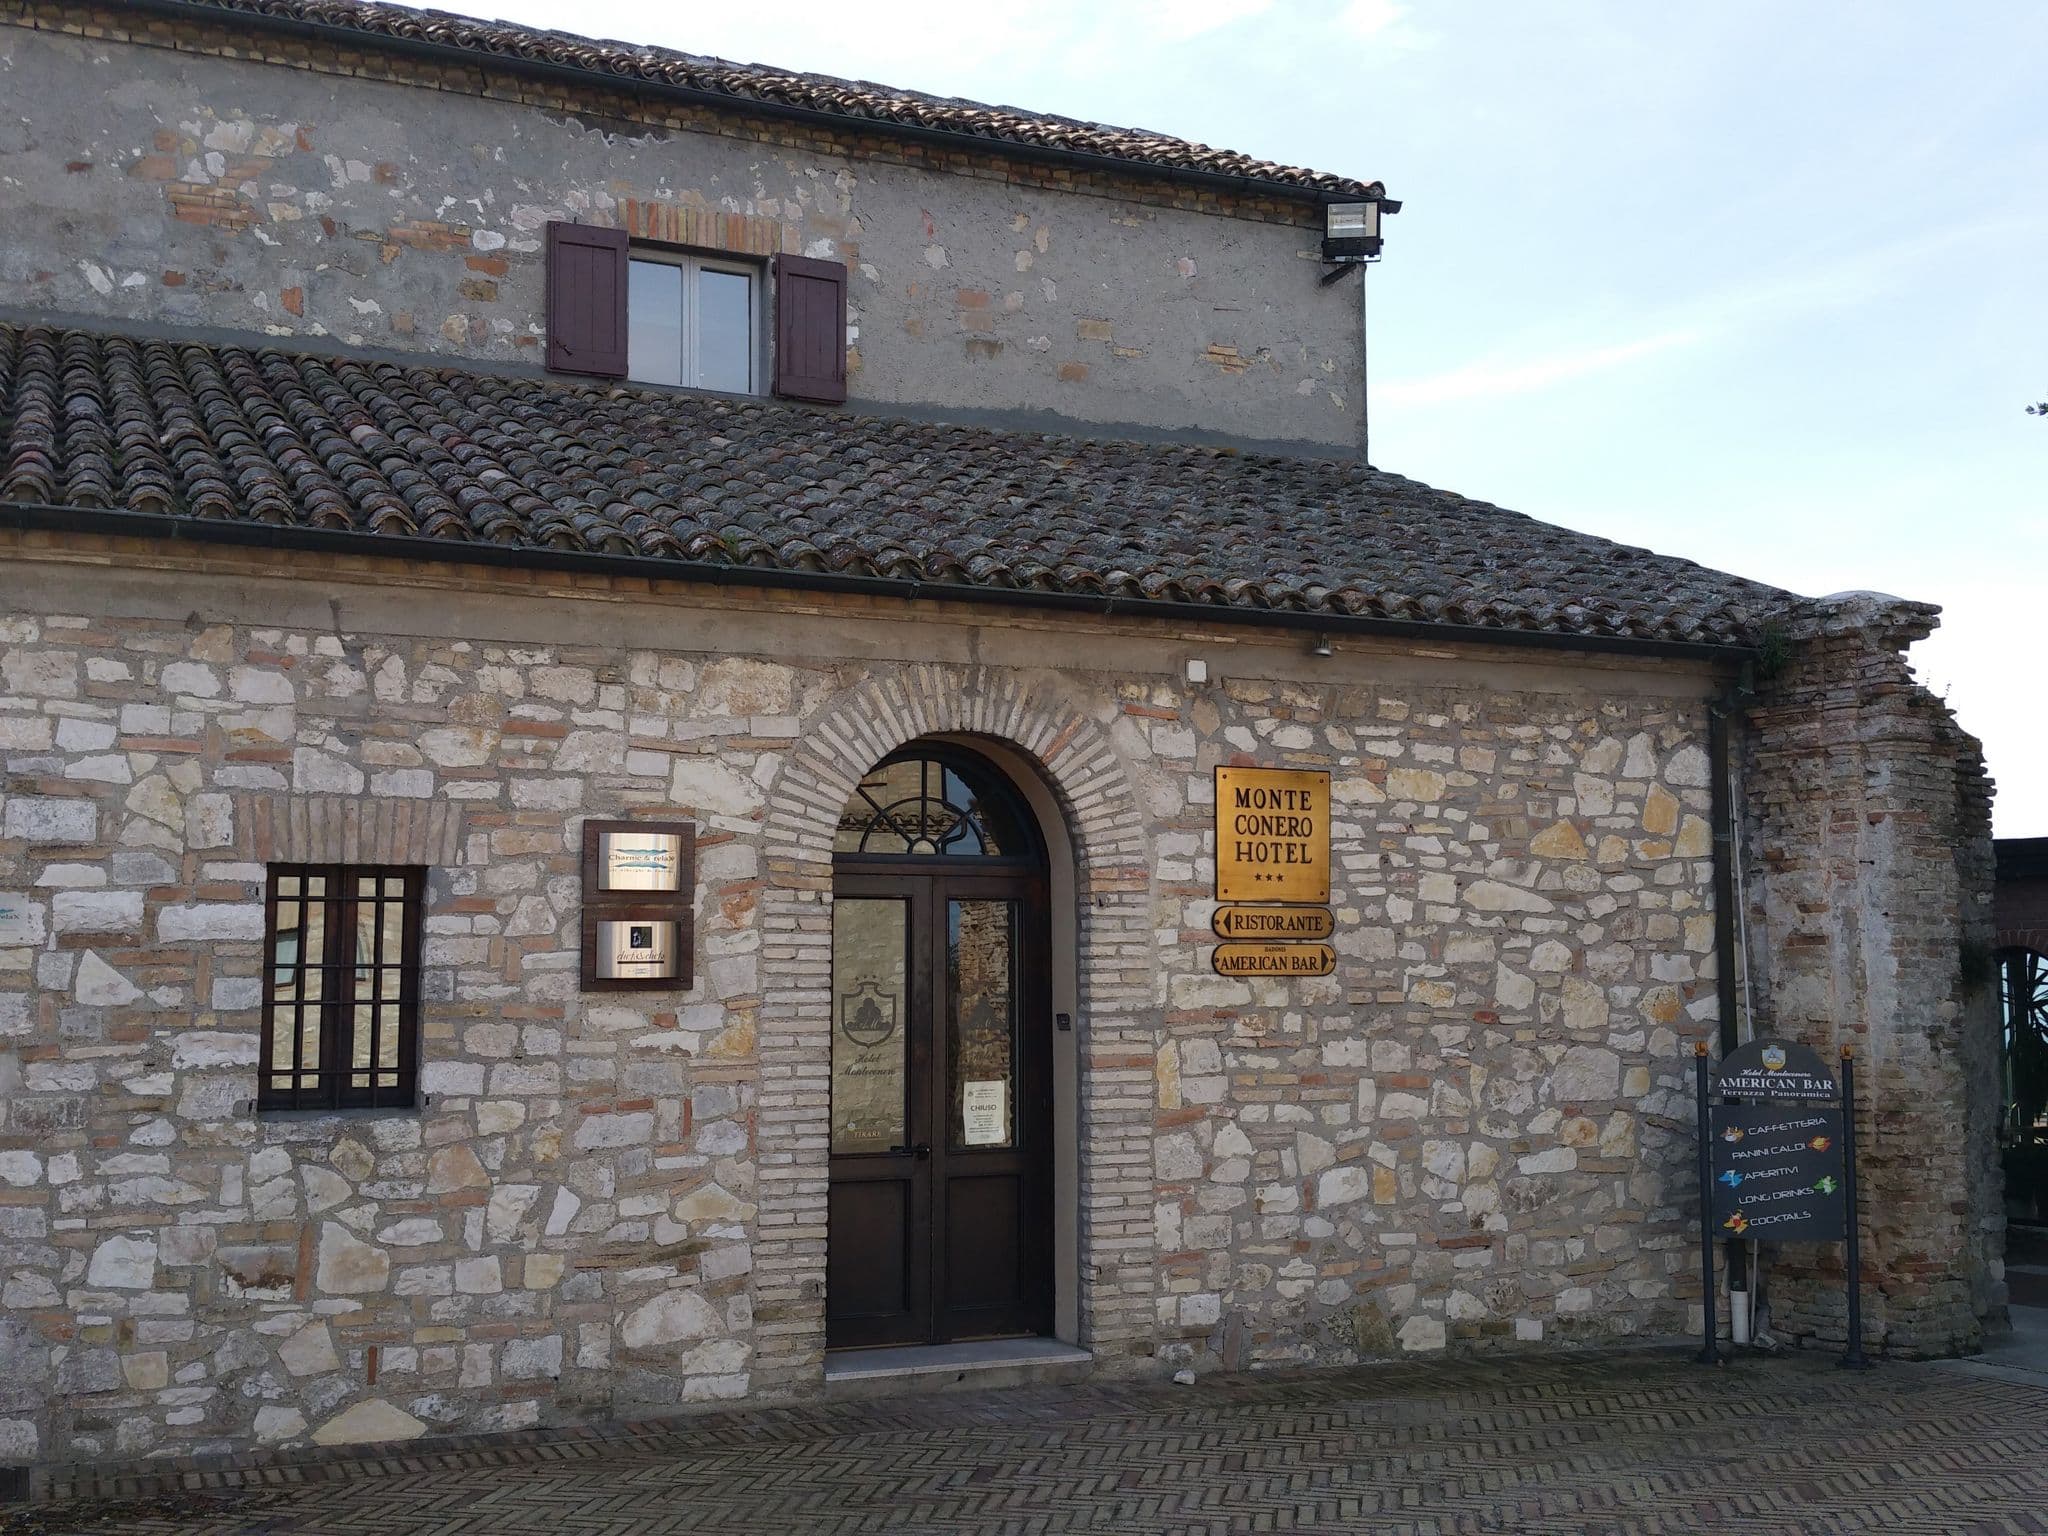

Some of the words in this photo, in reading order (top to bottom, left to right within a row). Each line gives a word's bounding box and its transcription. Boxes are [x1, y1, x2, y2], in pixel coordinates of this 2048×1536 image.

[1235, 787, 1312, 811] MONTE
[1235, 814, 1313, 838] CONERO
[1235, 841, 1313, 865] HOTEL
[1234, 914, 1323, 931] RISTORANTE
[1220, 955, 1288, 971] AMERICAN
[1292, 956, 1319, 971] BAR
[1718, 1077, 1796, 1089] AMERICAN
[1803, 1079, 1833, 1090] BAR
[1720, 1089, 1765, 1097] Terrazza
[1770, 1090, 1831, 1098] Panoramica
[970, 1104, 997, 1112] CHIUSO
[1748, 1117, 1828, 1136] CAFFETTERIA
[1731, 1148, 1769, 1160] PANINI
[1771, 1143, 1806, 1155] CALDI
[1744, 1166, 1799, 1181] APERITIVI
[1738, 1192, 1771, 1205] LONG
[1772, 1186, 1815, 1201] DRINKS
[1750, 1211, 1812, 1227] COCKTAILS
